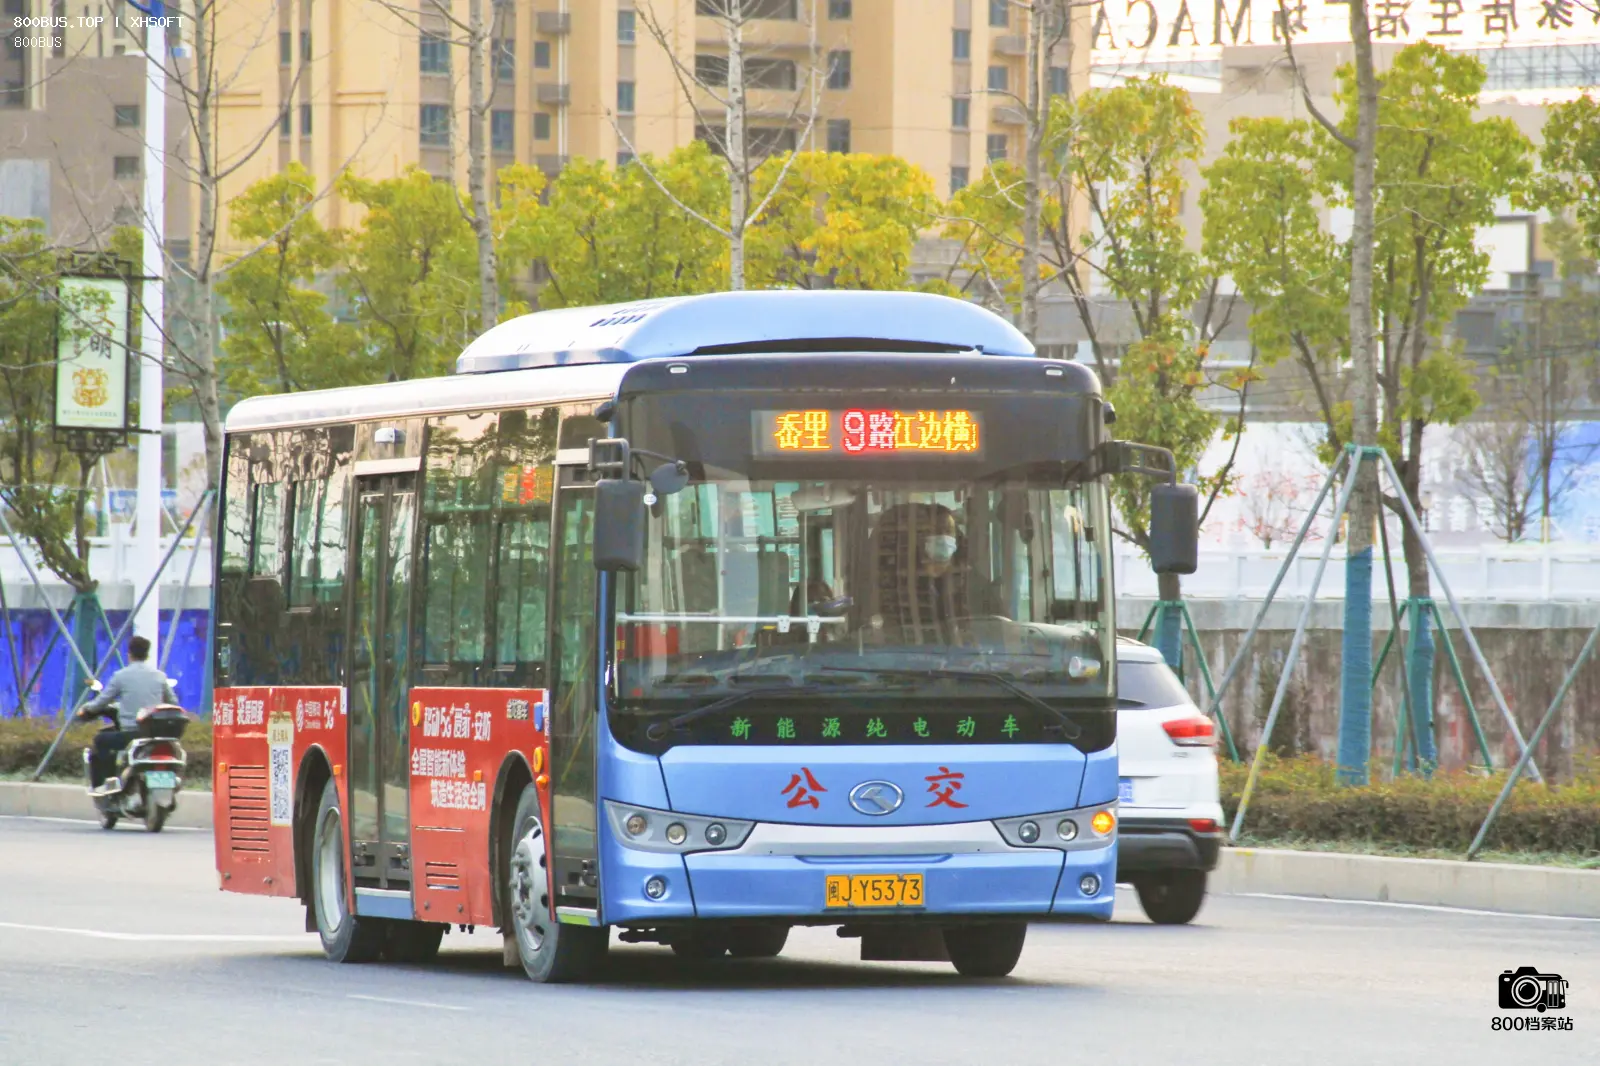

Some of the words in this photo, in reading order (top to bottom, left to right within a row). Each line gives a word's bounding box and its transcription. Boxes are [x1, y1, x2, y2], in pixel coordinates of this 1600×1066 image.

[894, 411, 977, 451] 江边横
[730, 714, 1021, 740] 新能源纯电动车
